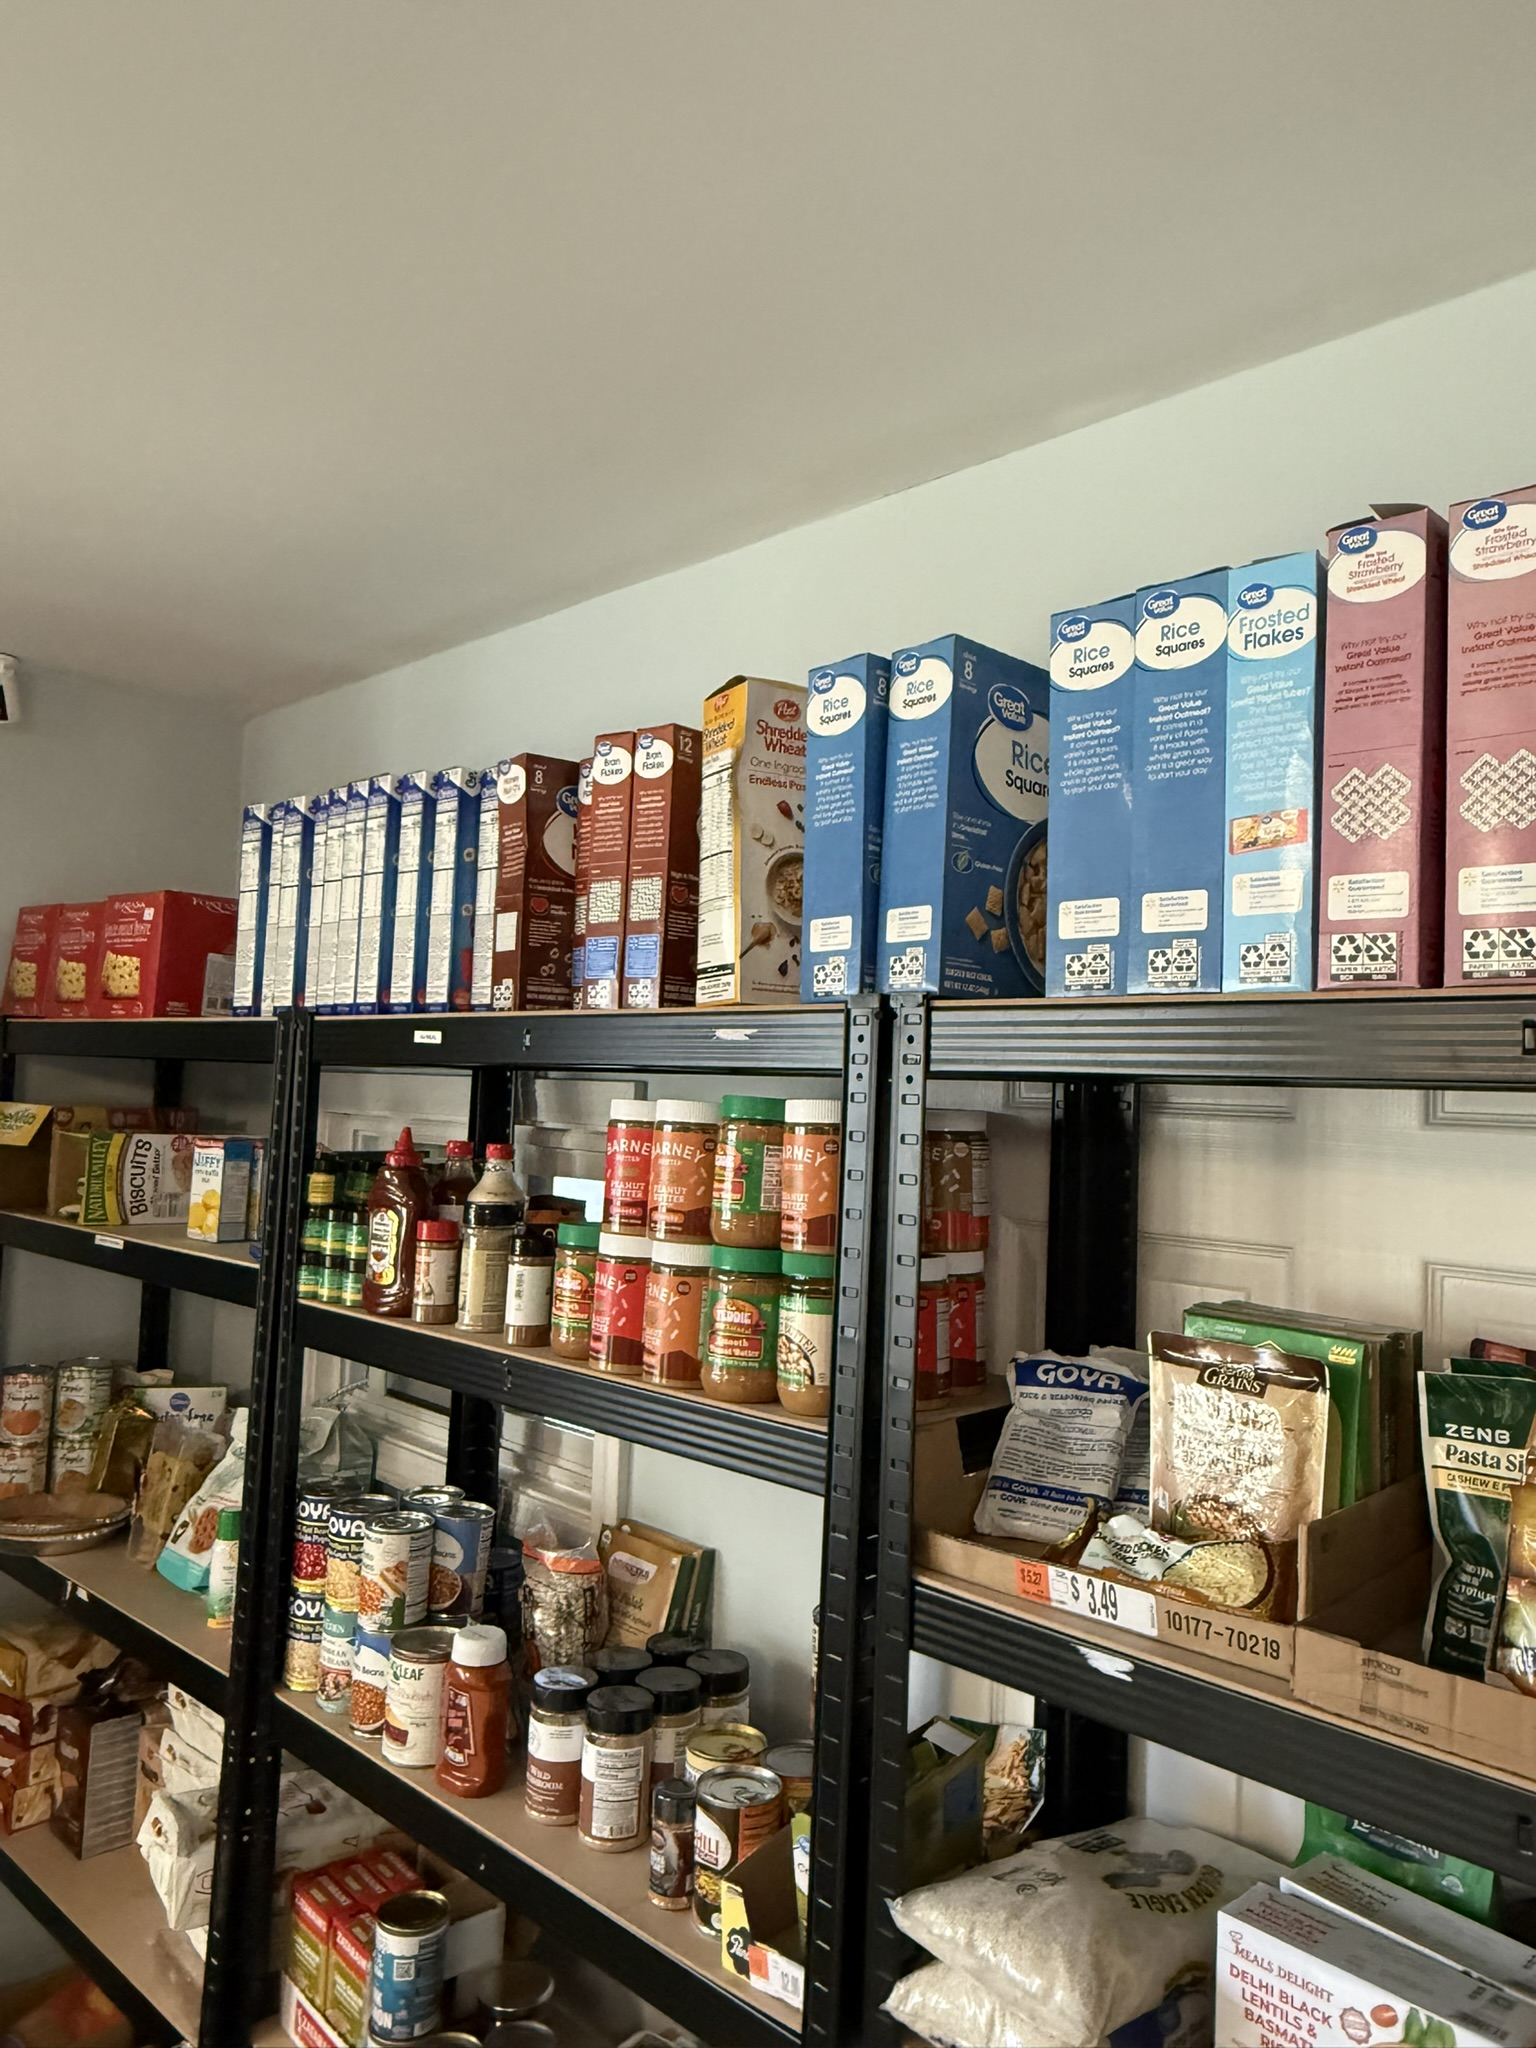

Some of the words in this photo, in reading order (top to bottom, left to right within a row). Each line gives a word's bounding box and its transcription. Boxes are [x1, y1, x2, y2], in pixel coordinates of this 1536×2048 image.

[1467, 505, 1499, 520] Great
[1342, 531, 1370, 545] Great
[1485, 528, 1527, 545] Frosted
[1475, 538, 1536, 556] Strawberry
[1358, 553, 1395, 569] Frosted
[1514, 552, 1536, 561] Whea
[1348, 562, 1404, 580] Strawberry
[1240, 586, 1268, 602] Great
[1148, 596, 1174, 611] Great
[1238, 603, 1310, 634] Frosted
[1061, 621, 1085, 635] Great
[1160, 620, 1201, 643] Rice
[1474, 628, 1503, 641] Great
[1243, 624, 1305, 651] Flakes
[1073, 644, 1111, 665] Rice
[1155, 637, 1206, 658] Squares
[1461, 641, 1494, 654] Instant
[898, 656, 917, 671] Great
[964, 661, 974, 681] 8
[1068, 661, 1115, 679] Squares
[1335, 661, 1365, 673] Instant
[906, 678, 935, 696] Rice
[822, 696, 849, 714] Rice
[902, 693, 937, 709] Squares
[993, 692, 1026, 715] Great
[1158, 702, 1180, 713] Great
[1180, 699, 1203, 709] Value
[819, 710, 852, 726] Squares
[756, 719, 808, 743] Shredde
[680, 735, 693, 754] 12
[604, 758, 621, 767] Bran
[645, 751, 662, 760] Bran
[750, 756, 771, 769] One
[535, 769, 543, 785] 8
[748, 774, 788, 789] Endless
[1501, 961, 1535, 970] PLASTIC
[129, 1138, 153, 1217] BISCUITS
[1036, 1363, 1121, 1391] GOYA
[1203, 1366, 1261, 1394] GRAINS
[1444, 1423, 1511, 1445] ZENB
[1446, 1443, 1501, 1471] Pasta
[328, 1516, 365, 1537] OYA
[1070, 1574, 1081, 1603] $
[1087, 1577, 1118, 1622] 3.49
[1164, 1609, 1282, 1661] 10177-70219
[361, 1666, 385, 1677] Beans
[1234, 1944, 1275, 1974] MEALS
[1276, 1965, 1335, 2003] DELIGHT
[1229, 1962, 1275, 1998] DELHI
[1279, 1988, 1333, 2029] BLACK
[1241, 1987, 1303, 2031] LENTILS
[1307, 2022, 1318, 2040] &
